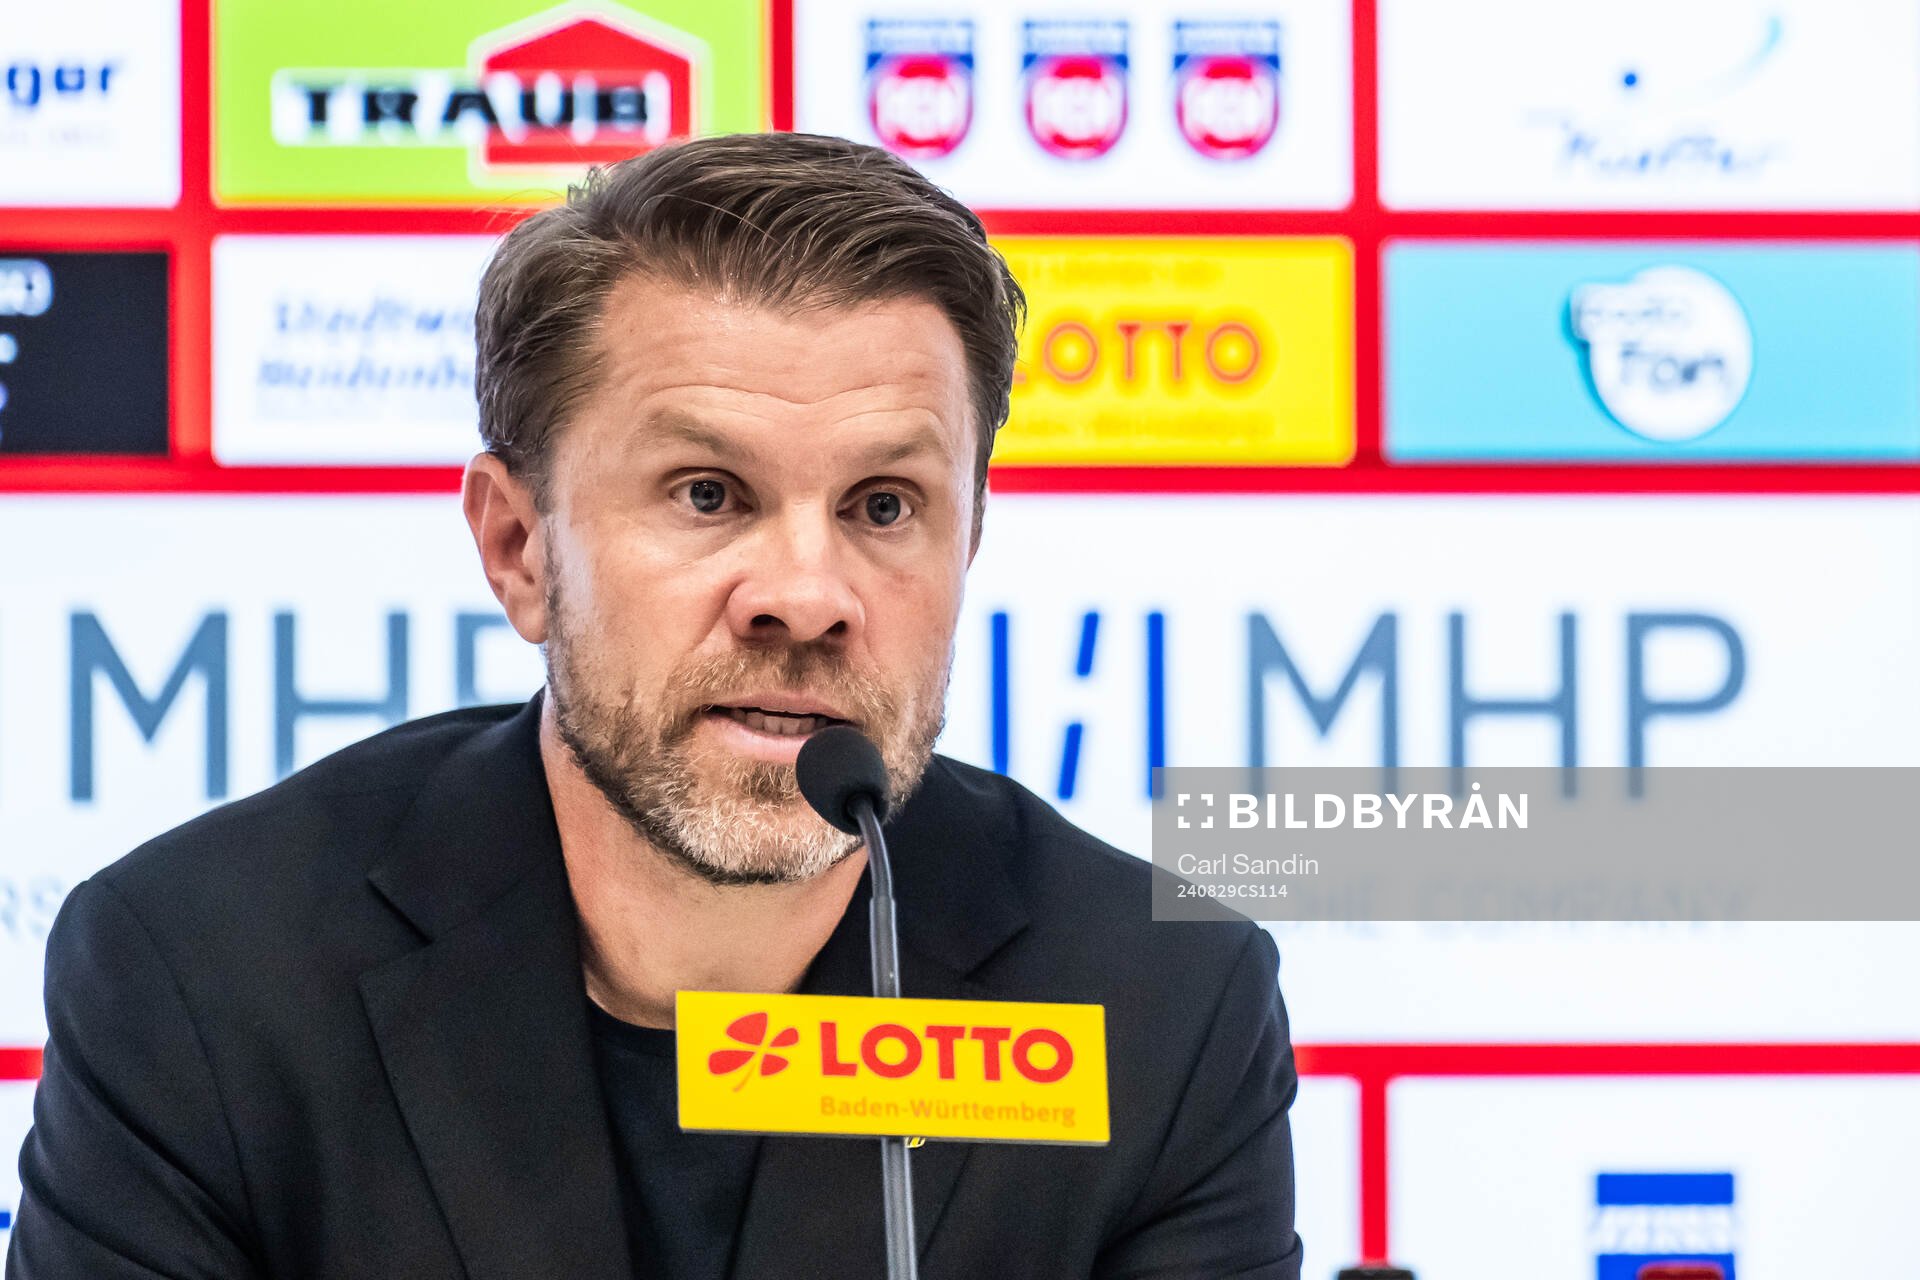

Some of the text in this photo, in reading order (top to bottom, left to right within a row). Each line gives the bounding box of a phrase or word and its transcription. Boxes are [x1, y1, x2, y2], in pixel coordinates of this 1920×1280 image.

[298, 85, 650, 127] TRAUB
[1012, 321, 1262, 384] OTTO
[1247, 611, 1748, 800] MHP
[820, 1020, 1075, 1084] LOTTO
[820, 1096, 1077, 1129] Baden-Württemberg
